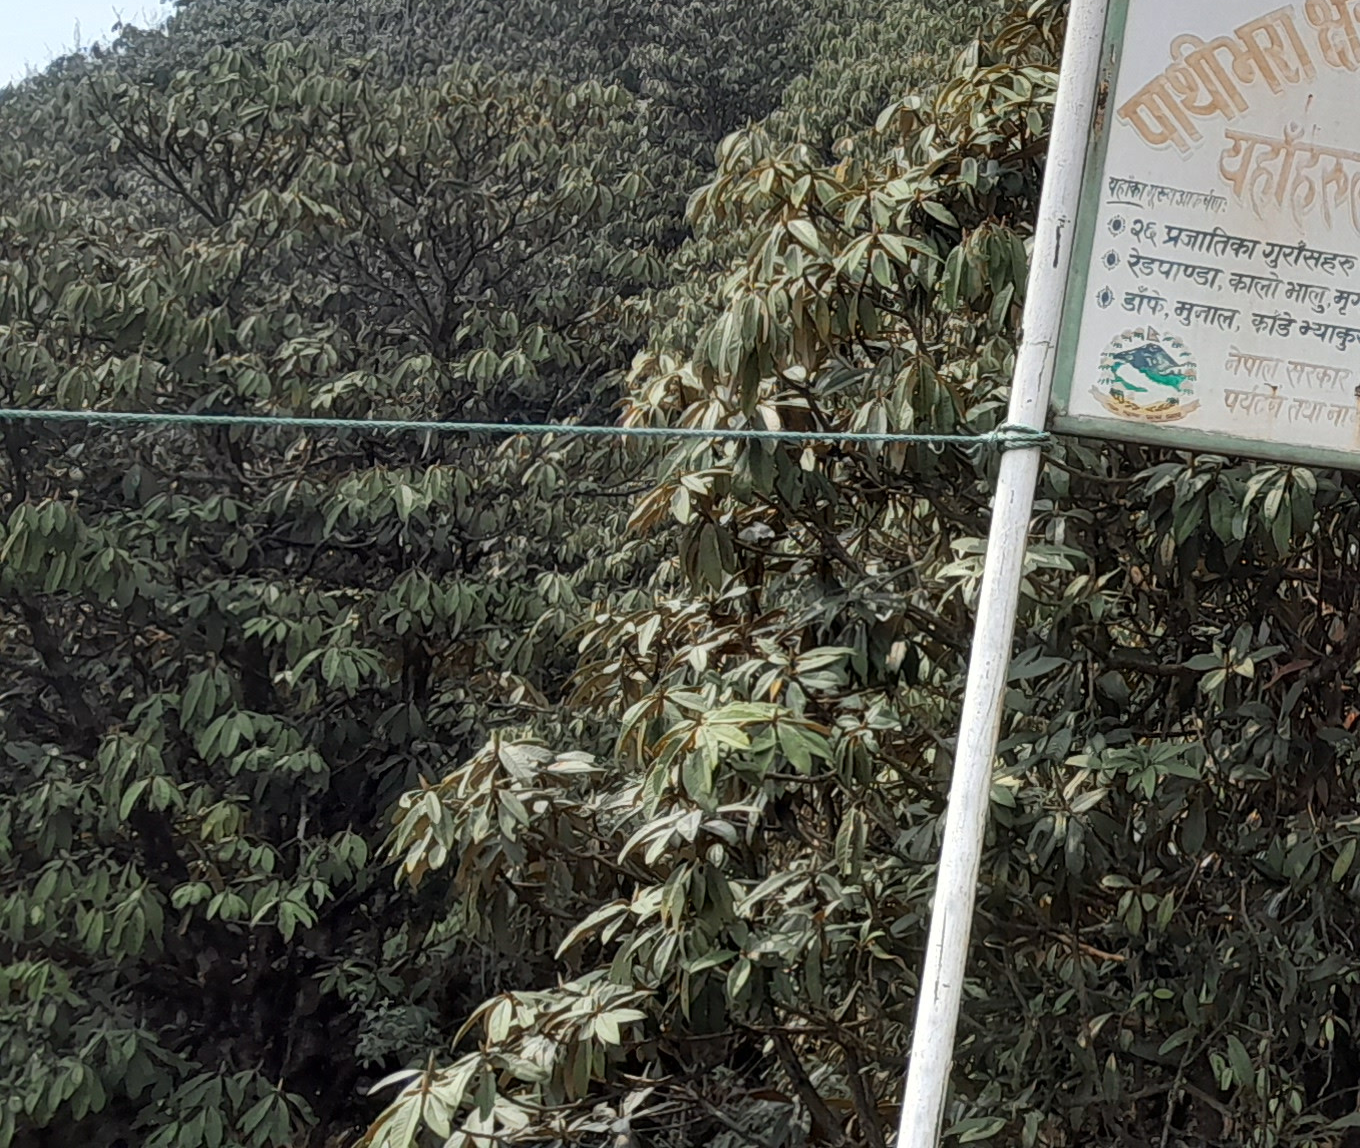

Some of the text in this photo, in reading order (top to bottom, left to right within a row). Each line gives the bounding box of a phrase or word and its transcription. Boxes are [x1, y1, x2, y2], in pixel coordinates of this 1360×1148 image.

[1116, 4, 1317, 154] पाथीभरा
[1130, 218, 1158, 247] २६
[1162, 224, 1260, 260] प्रजातिका
[1225, 346, 1353, 392] नेपाल सरकार
[1288, 398, 1327, 423] तथा
